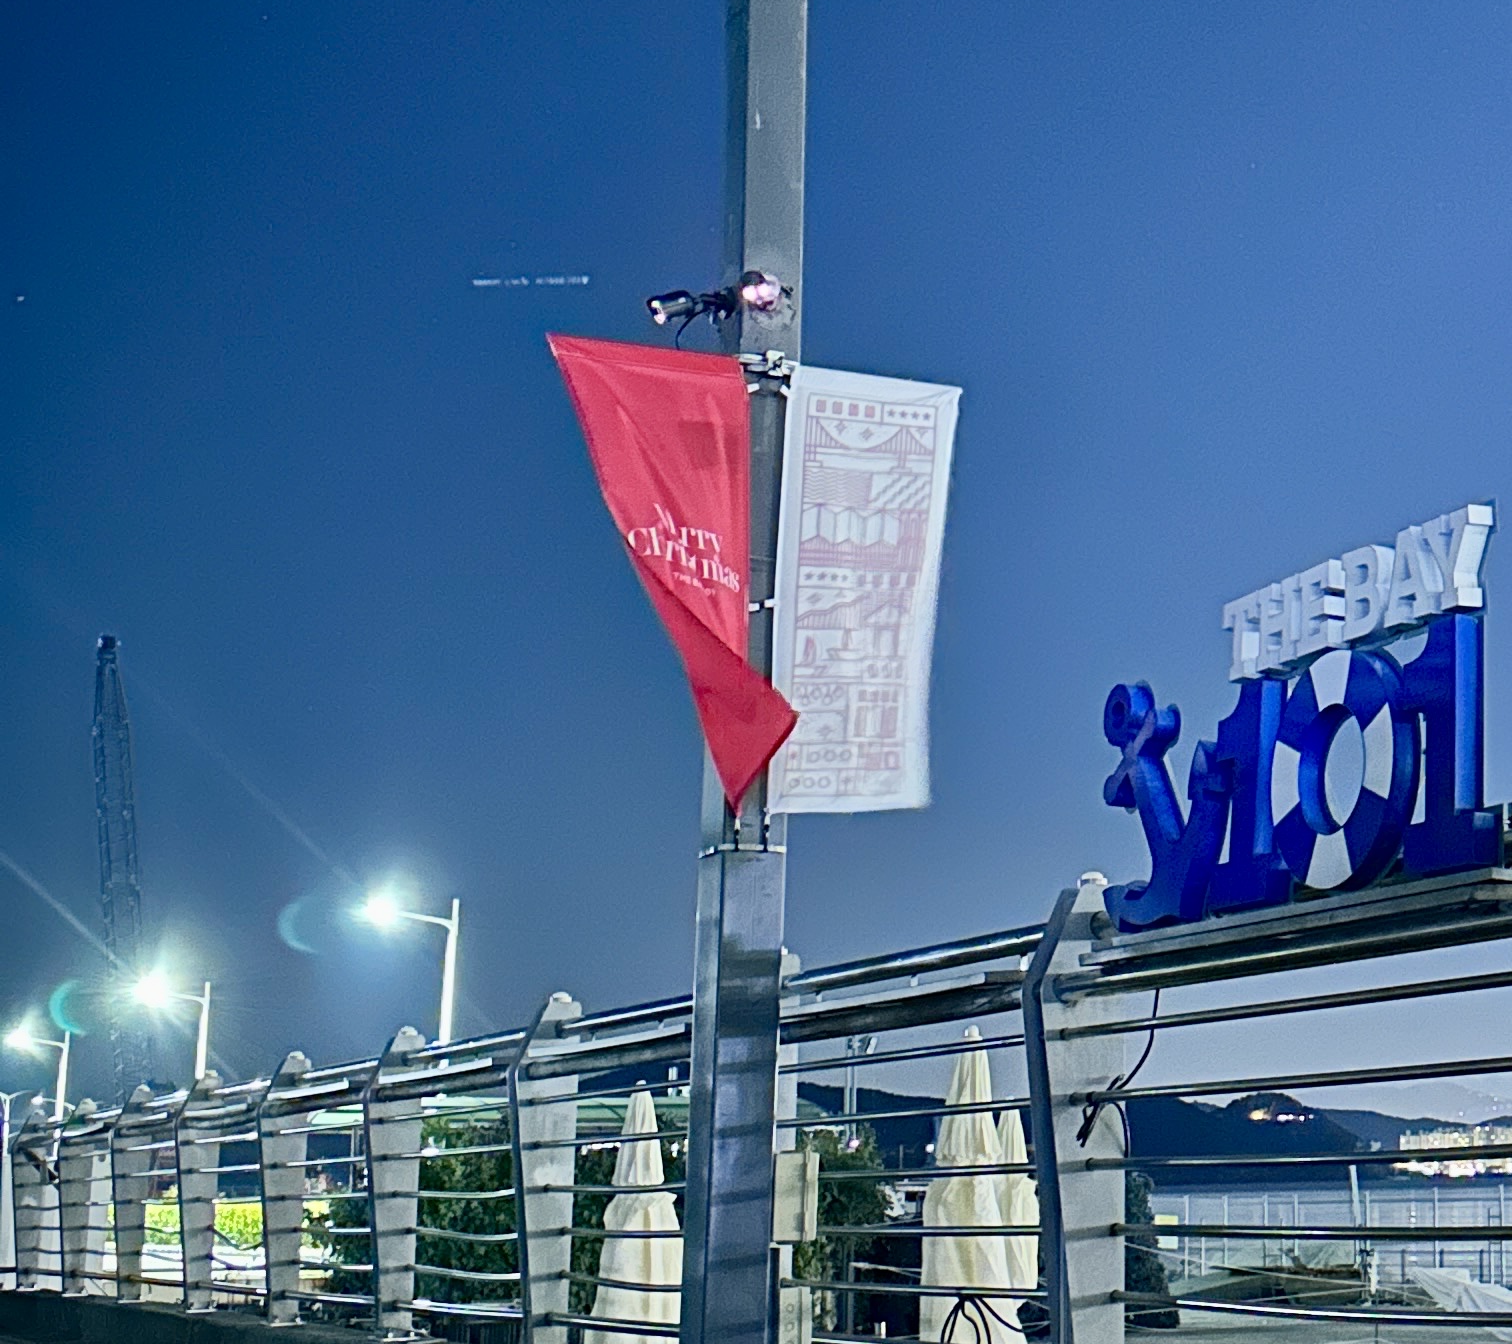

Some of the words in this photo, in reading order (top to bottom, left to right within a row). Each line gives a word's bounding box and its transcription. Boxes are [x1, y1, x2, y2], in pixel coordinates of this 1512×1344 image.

[1223, 557, 1345, 683] THE
[1342, 503, 1494, 648] BAY
[1209, 613, 1503, 913] 101
